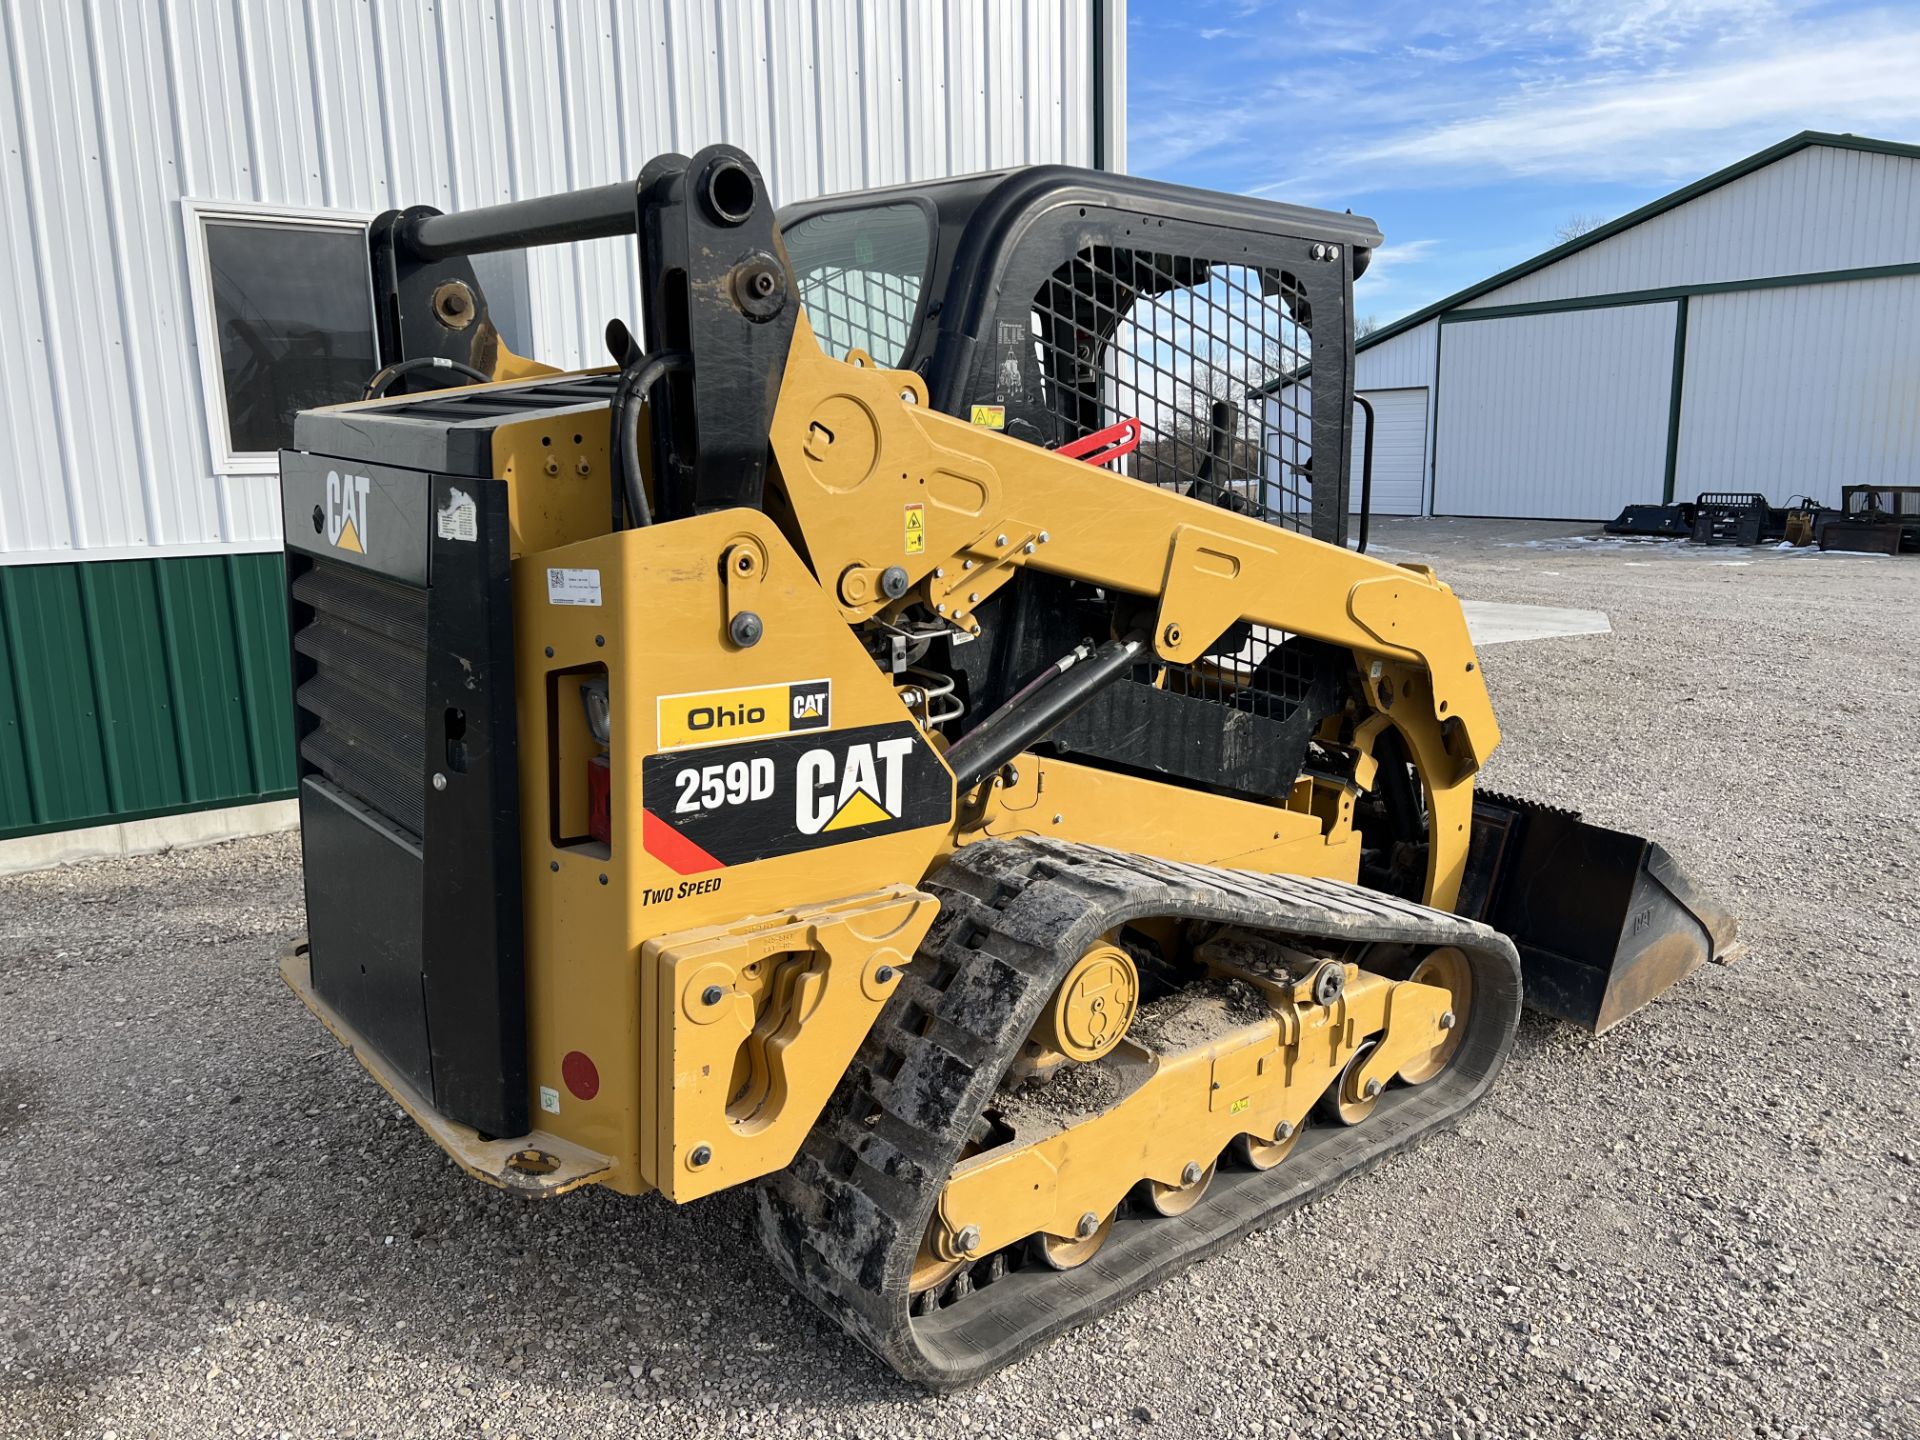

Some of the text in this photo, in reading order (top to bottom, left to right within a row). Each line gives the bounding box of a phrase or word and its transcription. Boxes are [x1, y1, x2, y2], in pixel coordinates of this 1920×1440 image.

[326, 470, 370, 555] CAT
[687, 693, 826, 731] Ohio CAT
[674, 736, 913, 835] 259D CAT
